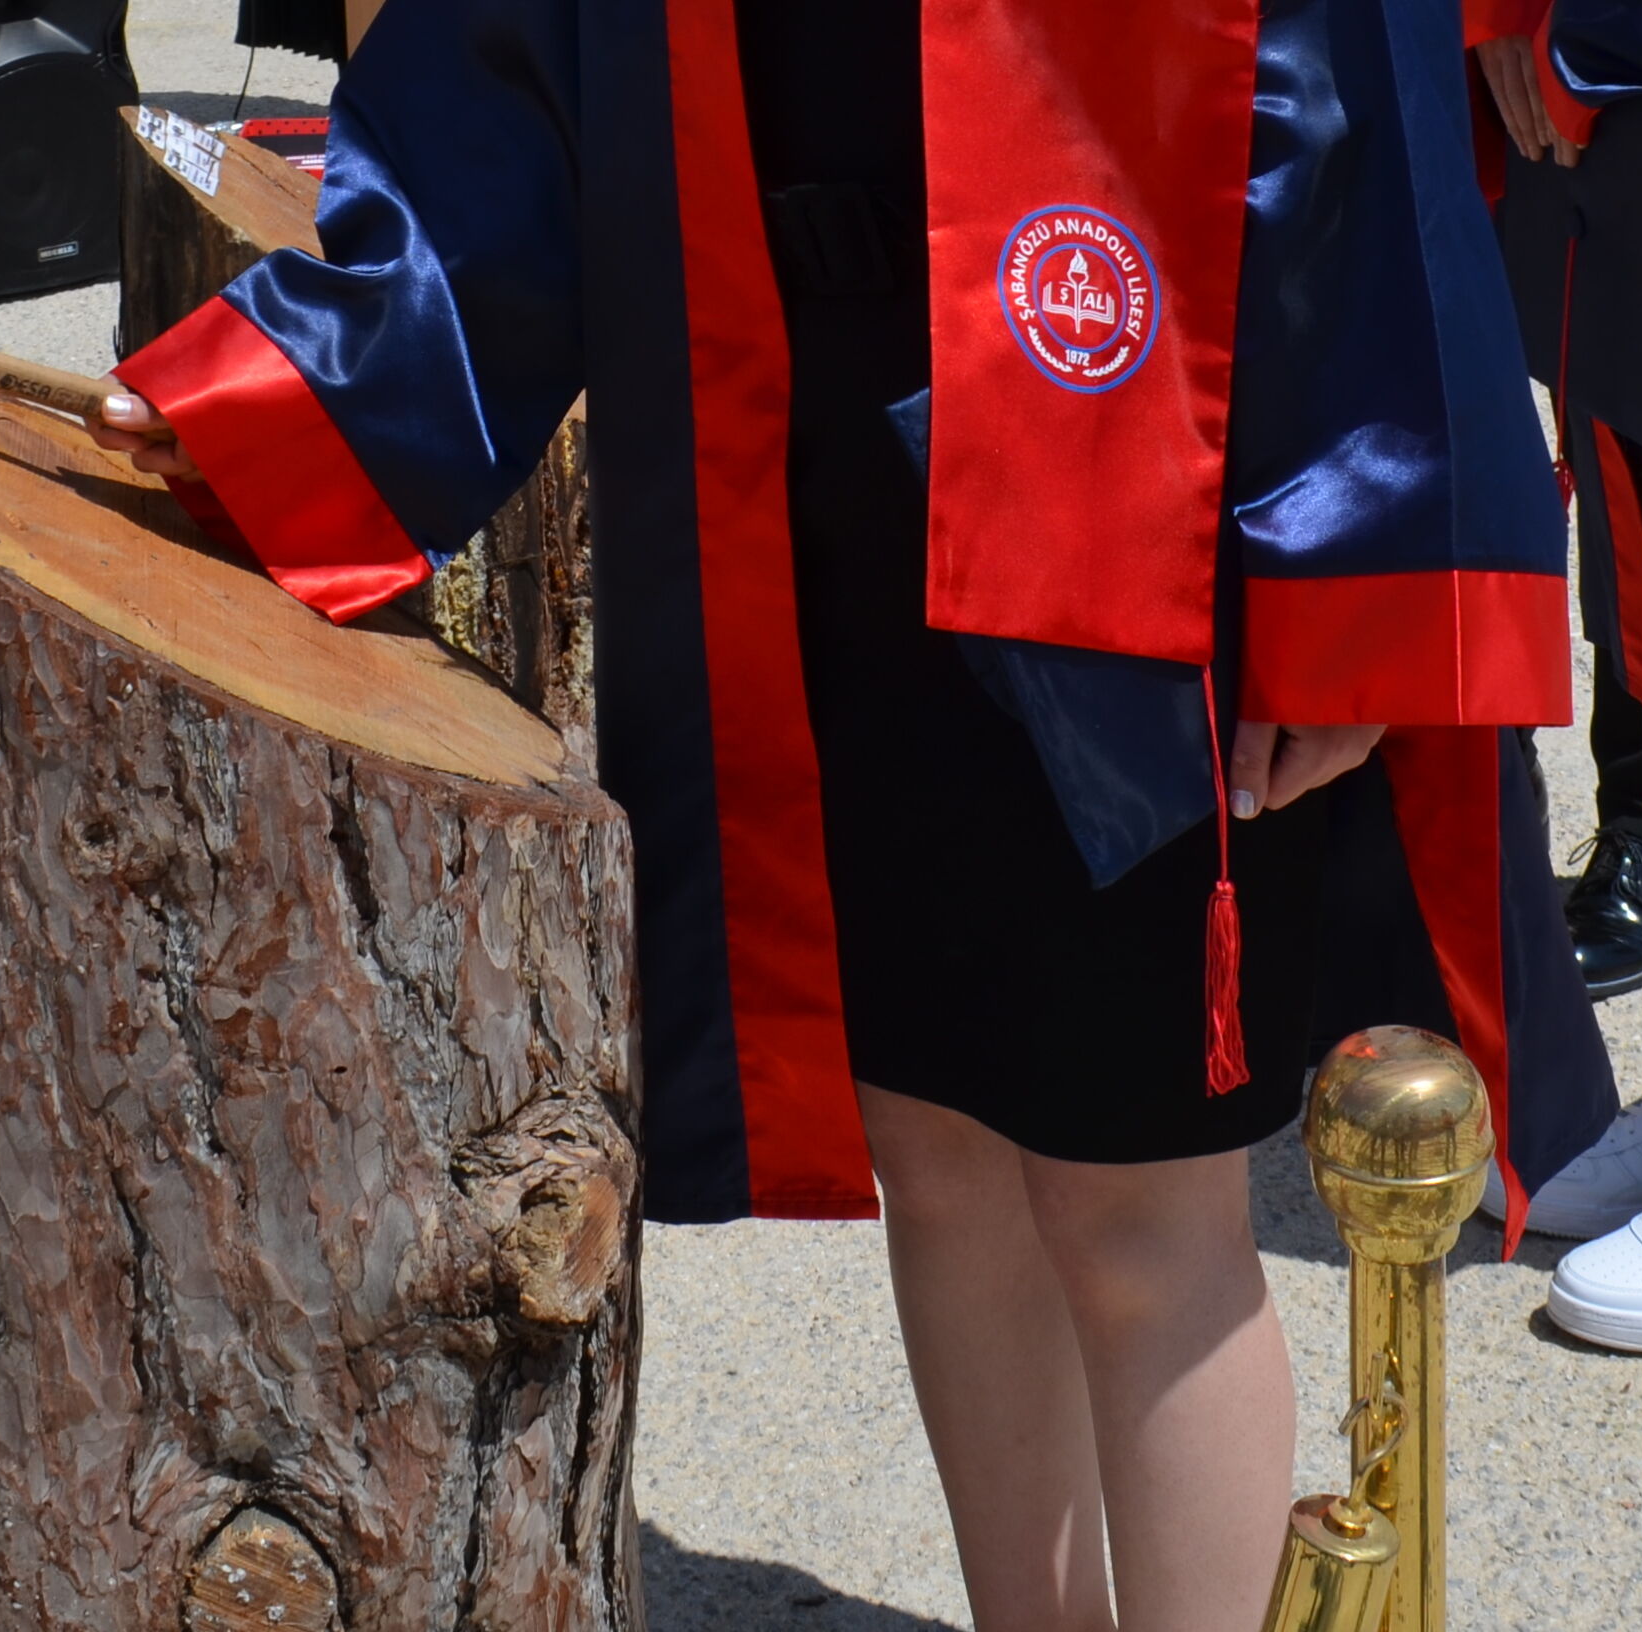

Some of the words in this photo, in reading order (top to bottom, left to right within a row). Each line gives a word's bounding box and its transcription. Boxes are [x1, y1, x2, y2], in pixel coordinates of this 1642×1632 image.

[1010, 221, 1051, 322] ŞABANÖZÜ
[1055, 218, 1136, 272] ANADOLU
[1082, 292, 1105, 310] AL
[1065, 349, 1090, 367] 1972
